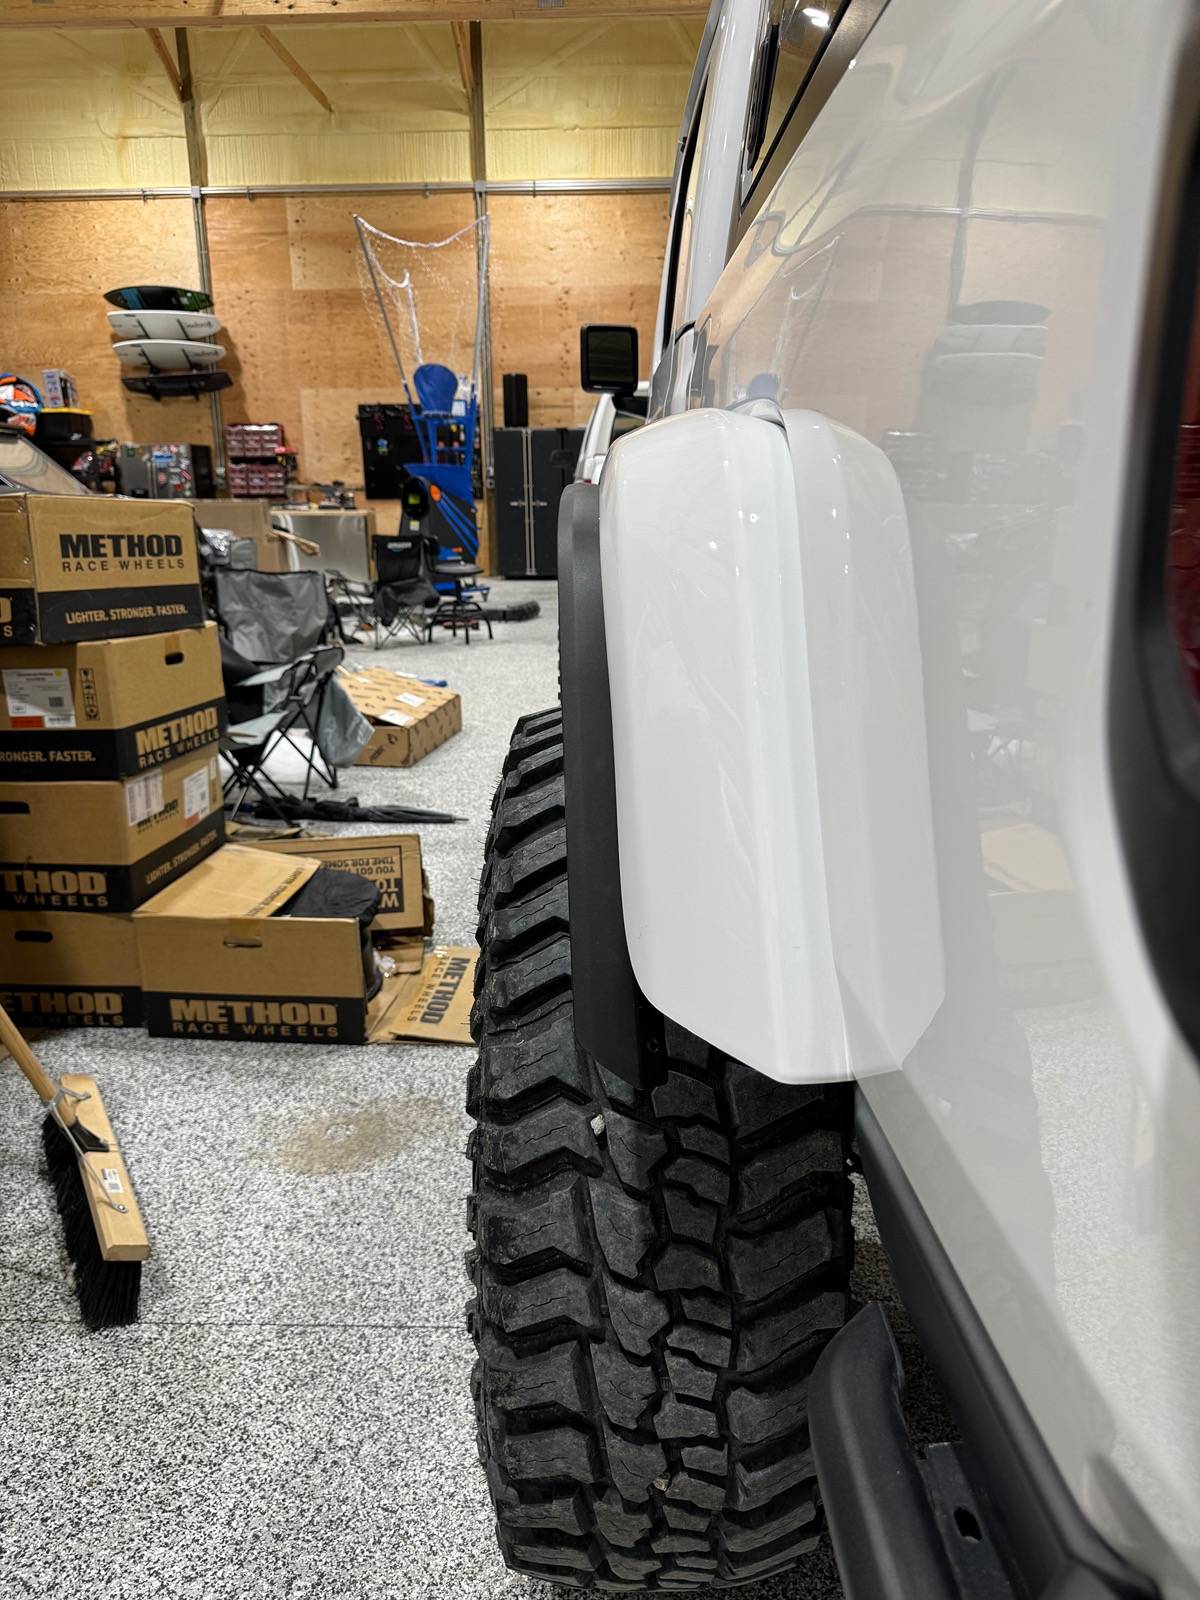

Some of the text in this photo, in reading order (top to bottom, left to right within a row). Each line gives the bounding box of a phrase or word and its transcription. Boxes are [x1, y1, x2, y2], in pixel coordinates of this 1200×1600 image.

[59, 534, 183, 559] METHOD
[62, 558, 185, 572] RACE WHEELS
[65, 604, 188, 625] LIGHTER. STRONGER. FASTER.
[135, 707, 218, 755] METHOD
[48, 751, 96, 762] FASTER.
[138, 730, 220, 769] RACE WHEELS
[352, 857, 370, 866] FOR
[373, 856, 395, 865] TIME
[376, 866, 395, 874] YOU
[14, 895, 109, 907] WHEELS
[420, 957, 471, 1024] METHOD
[407, 983, 437, 1022] WHEELS
[170, 999, 338, 1026] METHOD
[172, 1022, 339, 1037] RACE WHEELS
